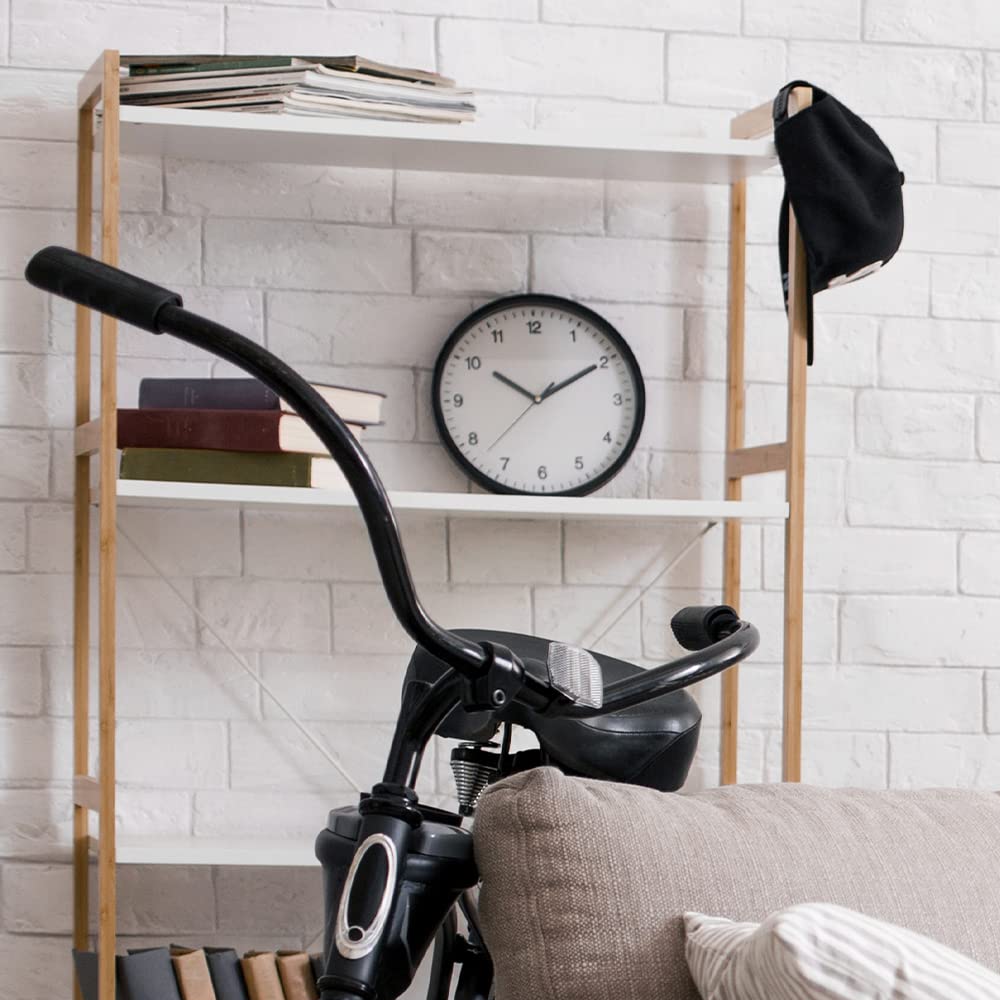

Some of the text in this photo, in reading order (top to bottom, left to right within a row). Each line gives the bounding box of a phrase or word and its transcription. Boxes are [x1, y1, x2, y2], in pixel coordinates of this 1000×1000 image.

[526, 321, 542, 335] 12
[491, 330, 503, 344] 11
[569, 330, 576, 342] 1
[465, 356, 482, 370] 10
[599, 356, 609, 369] 2
[453, 393, 464, 408] 9
[612, 393, 623, 406] 3
[467, 431, 479, 445] 8
[602, 431, 612, 444] 4
[500, 457, 510, 471] 7
[574, 456, 584, 470] 5
[537, 466, 548, 480] 6
